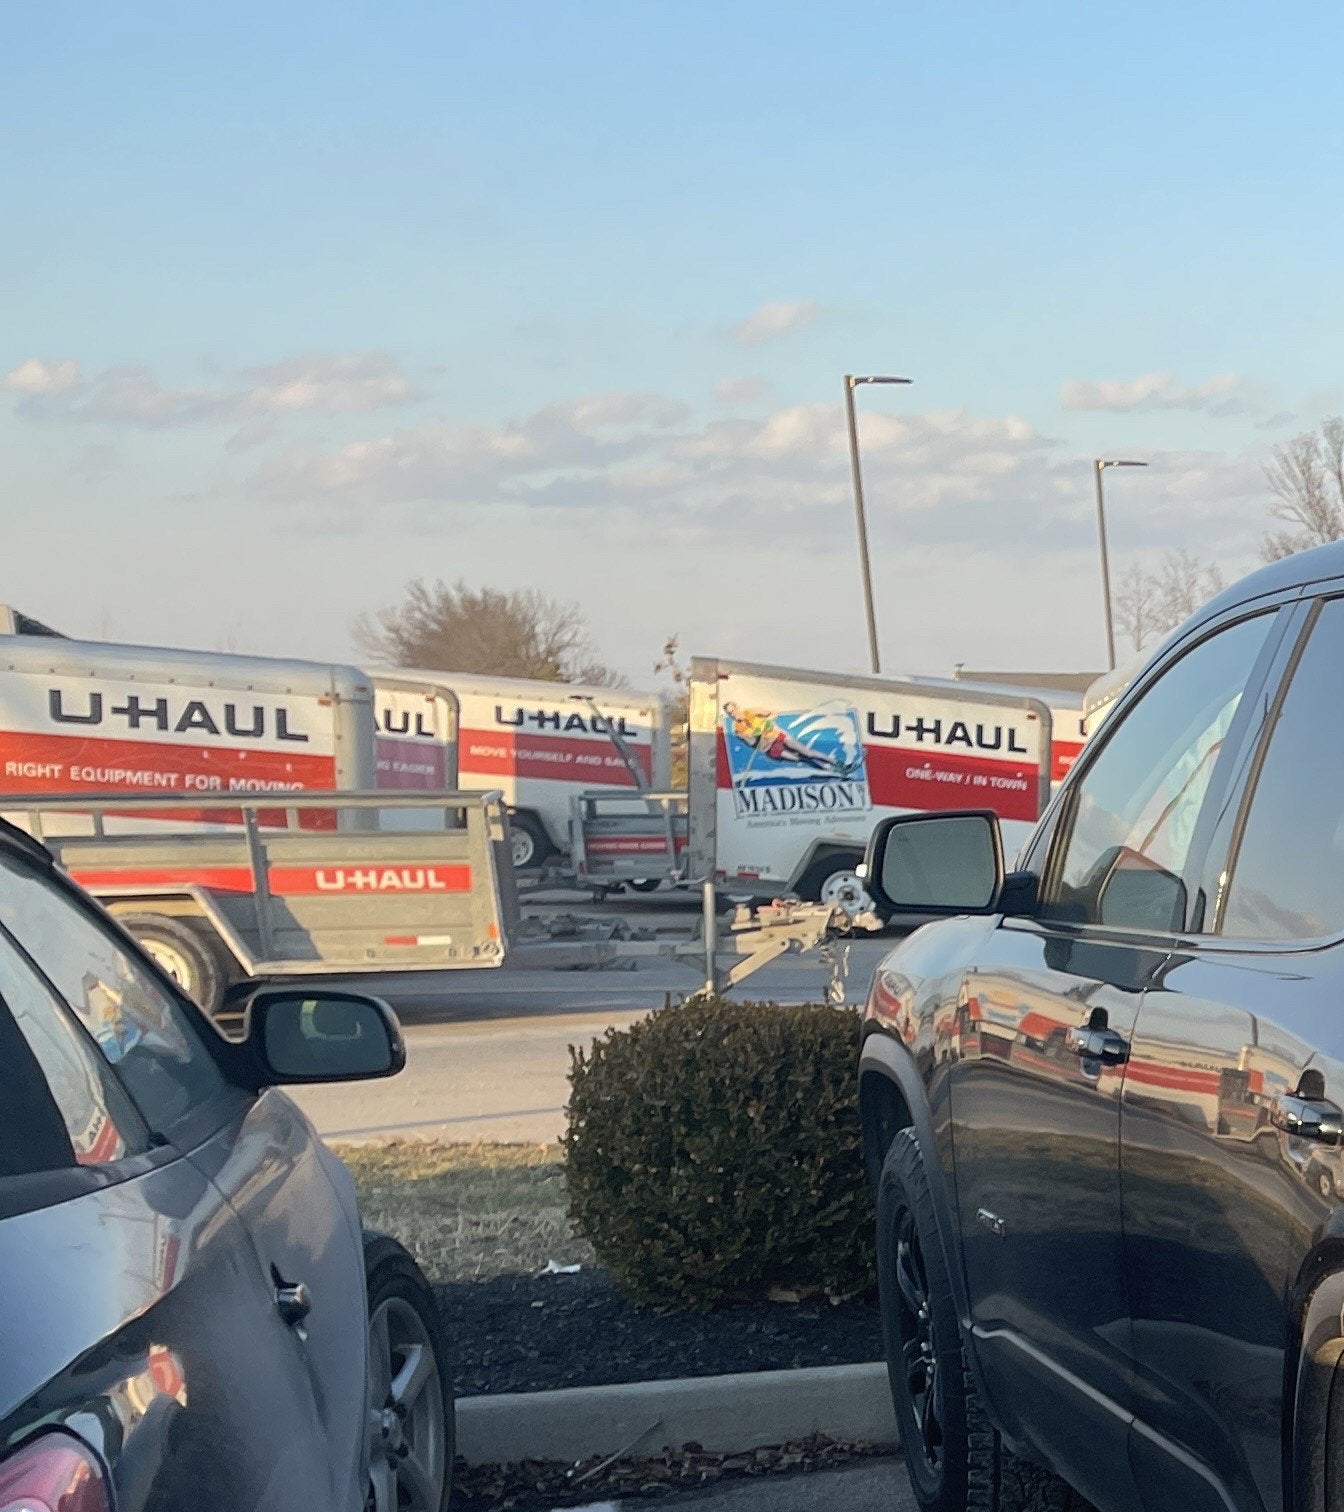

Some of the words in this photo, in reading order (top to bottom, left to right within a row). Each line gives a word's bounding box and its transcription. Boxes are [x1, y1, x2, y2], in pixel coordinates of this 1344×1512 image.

[48, 688, 309, 743] U-HAUL
[494, 705, 638, 738] U-HAUL
[866, 711, 1028, 754] U-HAUL
[5, 760, 63, 780] RIGHT
[69, 765, 179, 790] EQUIPMENT
[184, 773, 221, 792] FOR
[738, 783, 856, 814] MADISON
[315, 869, 447, 891] U-HAUL
